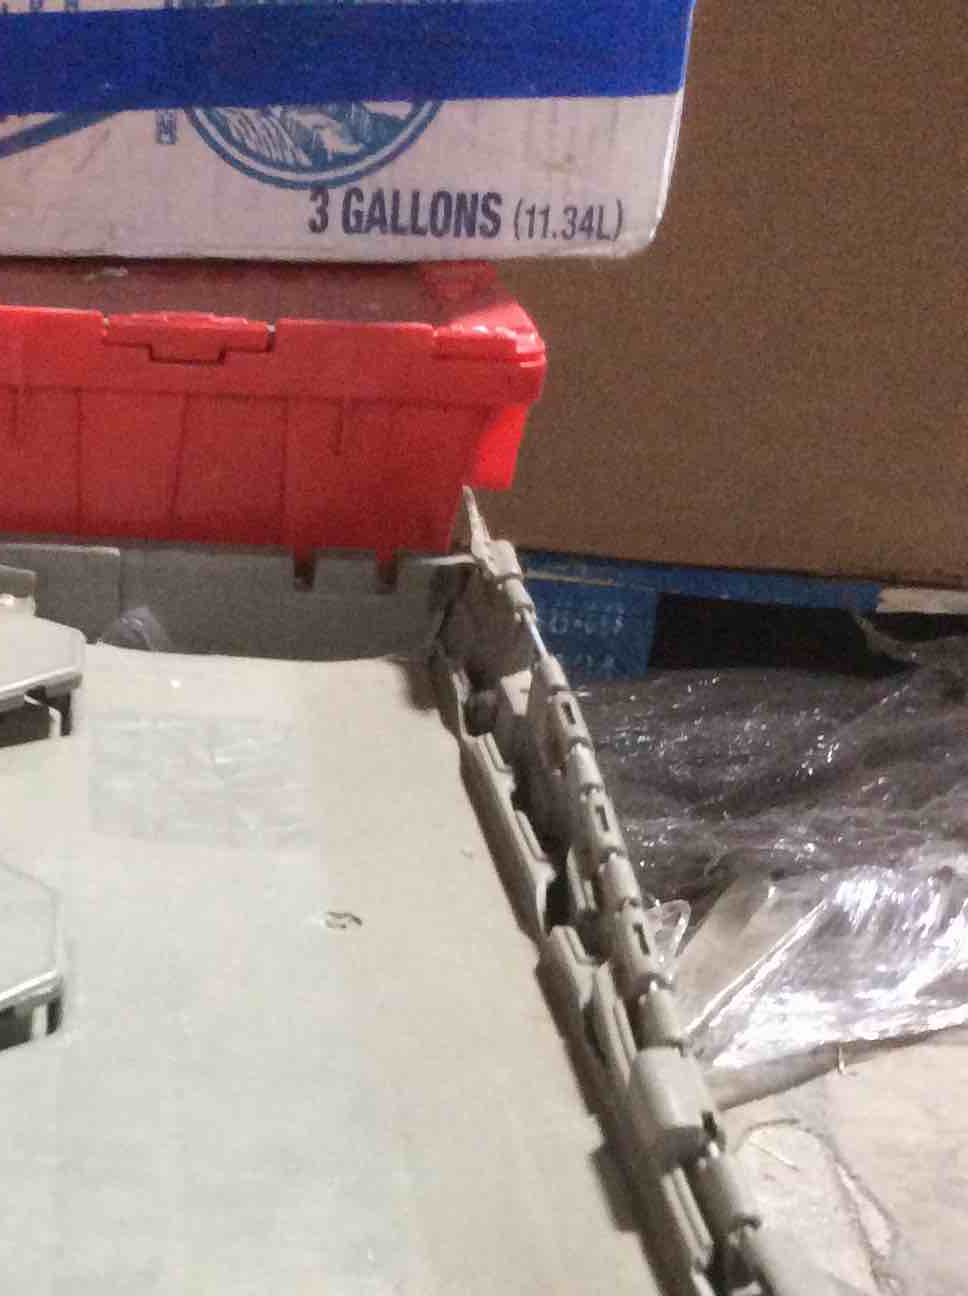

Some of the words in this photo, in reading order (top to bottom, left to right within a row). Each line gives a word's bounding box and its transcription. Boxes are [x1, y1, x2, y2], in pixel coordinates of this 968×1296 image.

[308, 186, 330, 235] 3
[340, 186, 503, 239] GALLONS
[513, 197, 624, 242] (11.34L)
